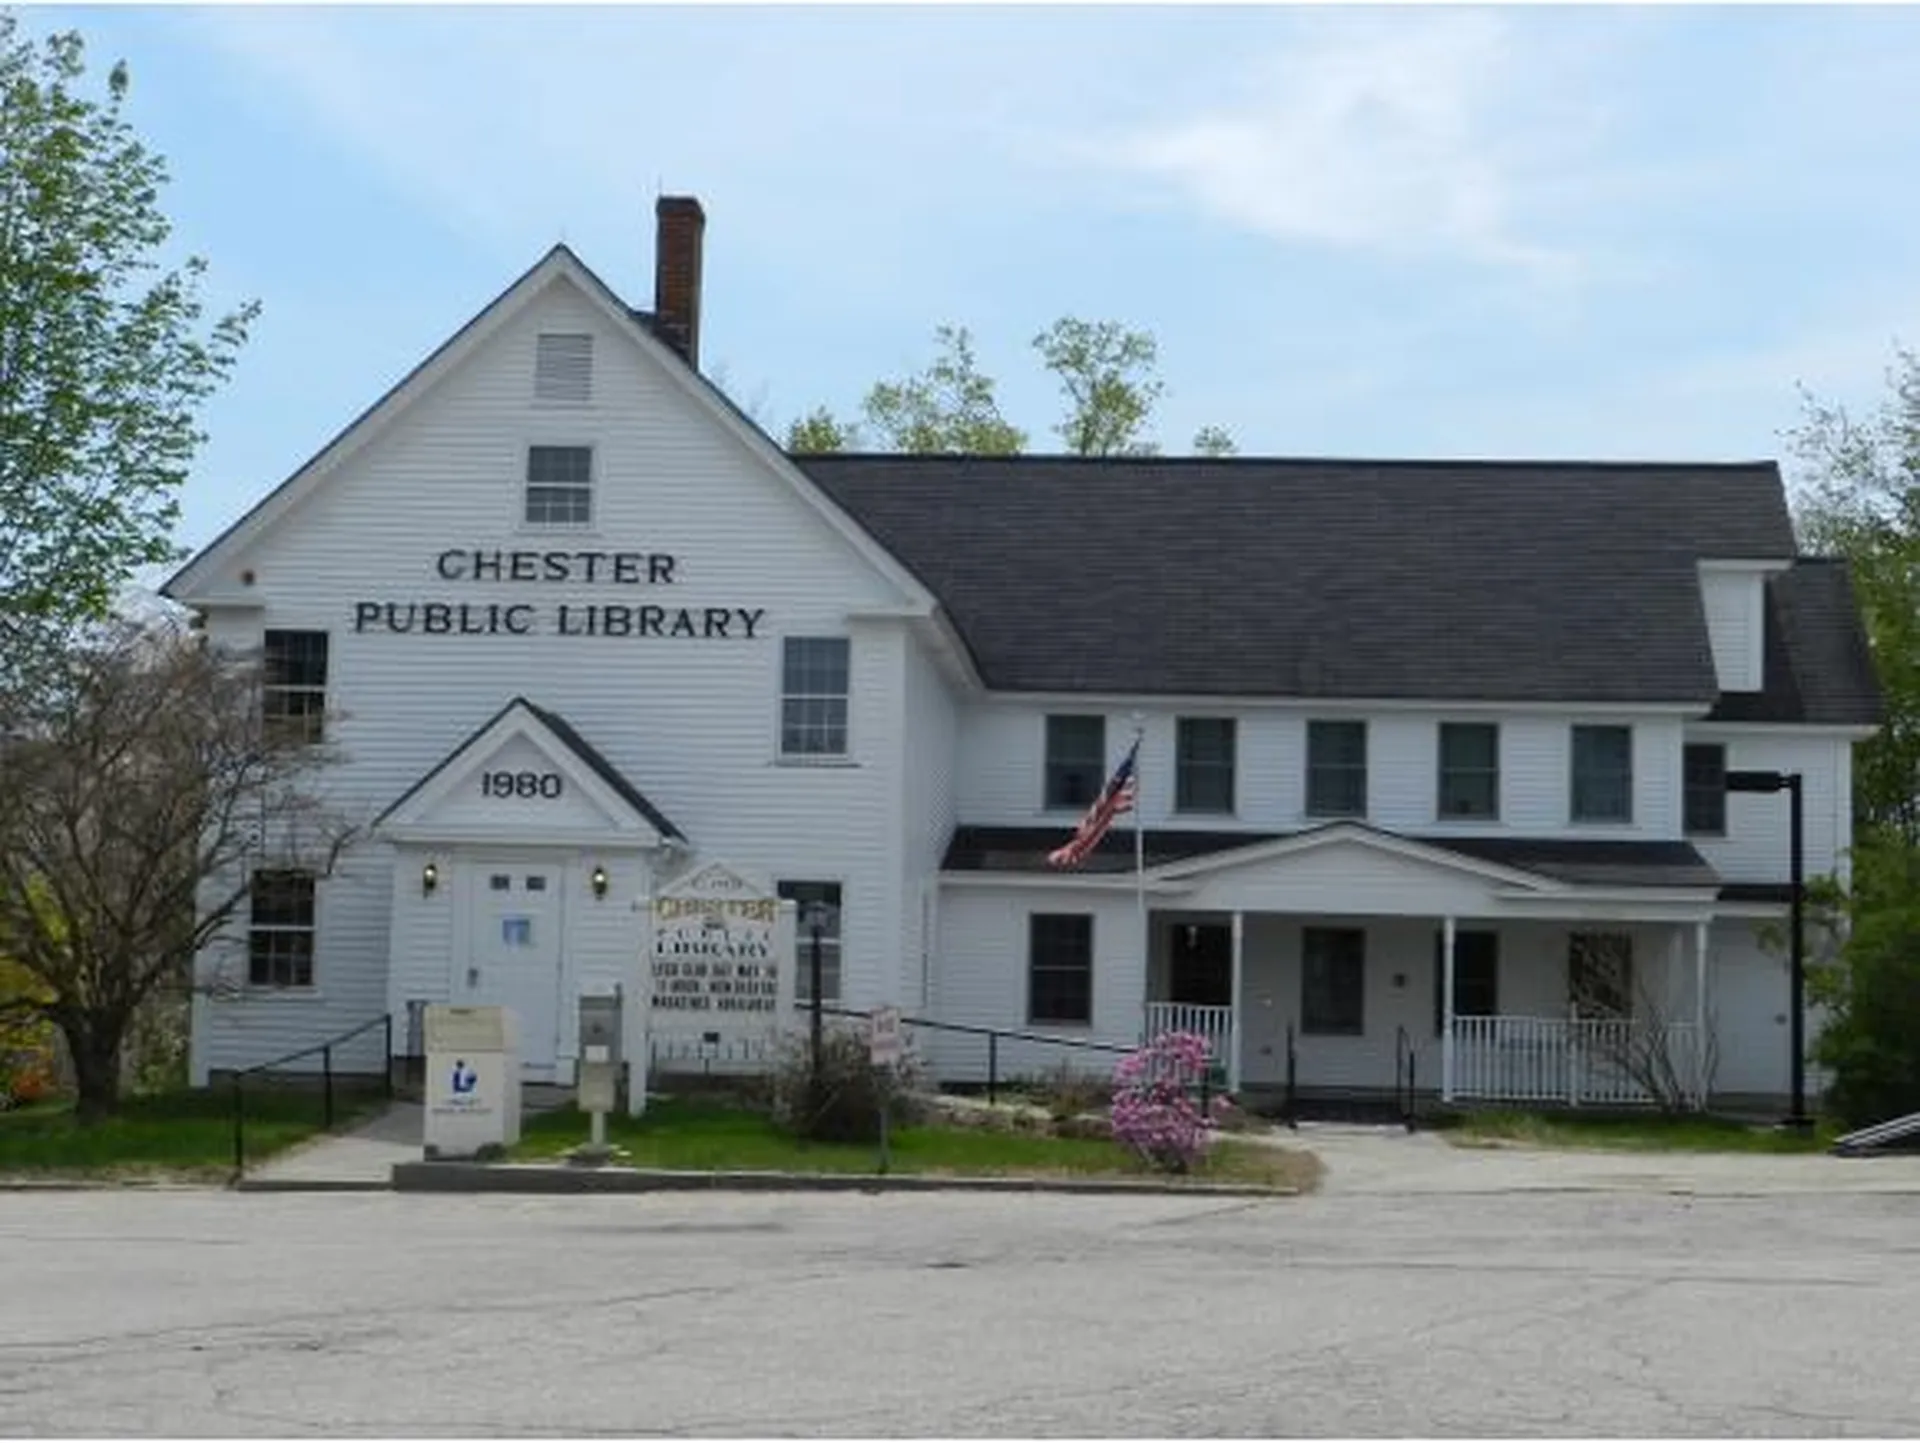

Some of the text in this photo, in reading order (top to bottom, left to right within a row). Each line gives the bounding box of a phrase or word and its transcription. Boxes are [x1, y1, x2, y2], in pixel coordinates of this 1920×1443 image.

[437, 549, 677, 584] CHESTER
[354, 602, 765, 639] PUBLIC LIBRARY
[483, 771, 562, 799] 1980
